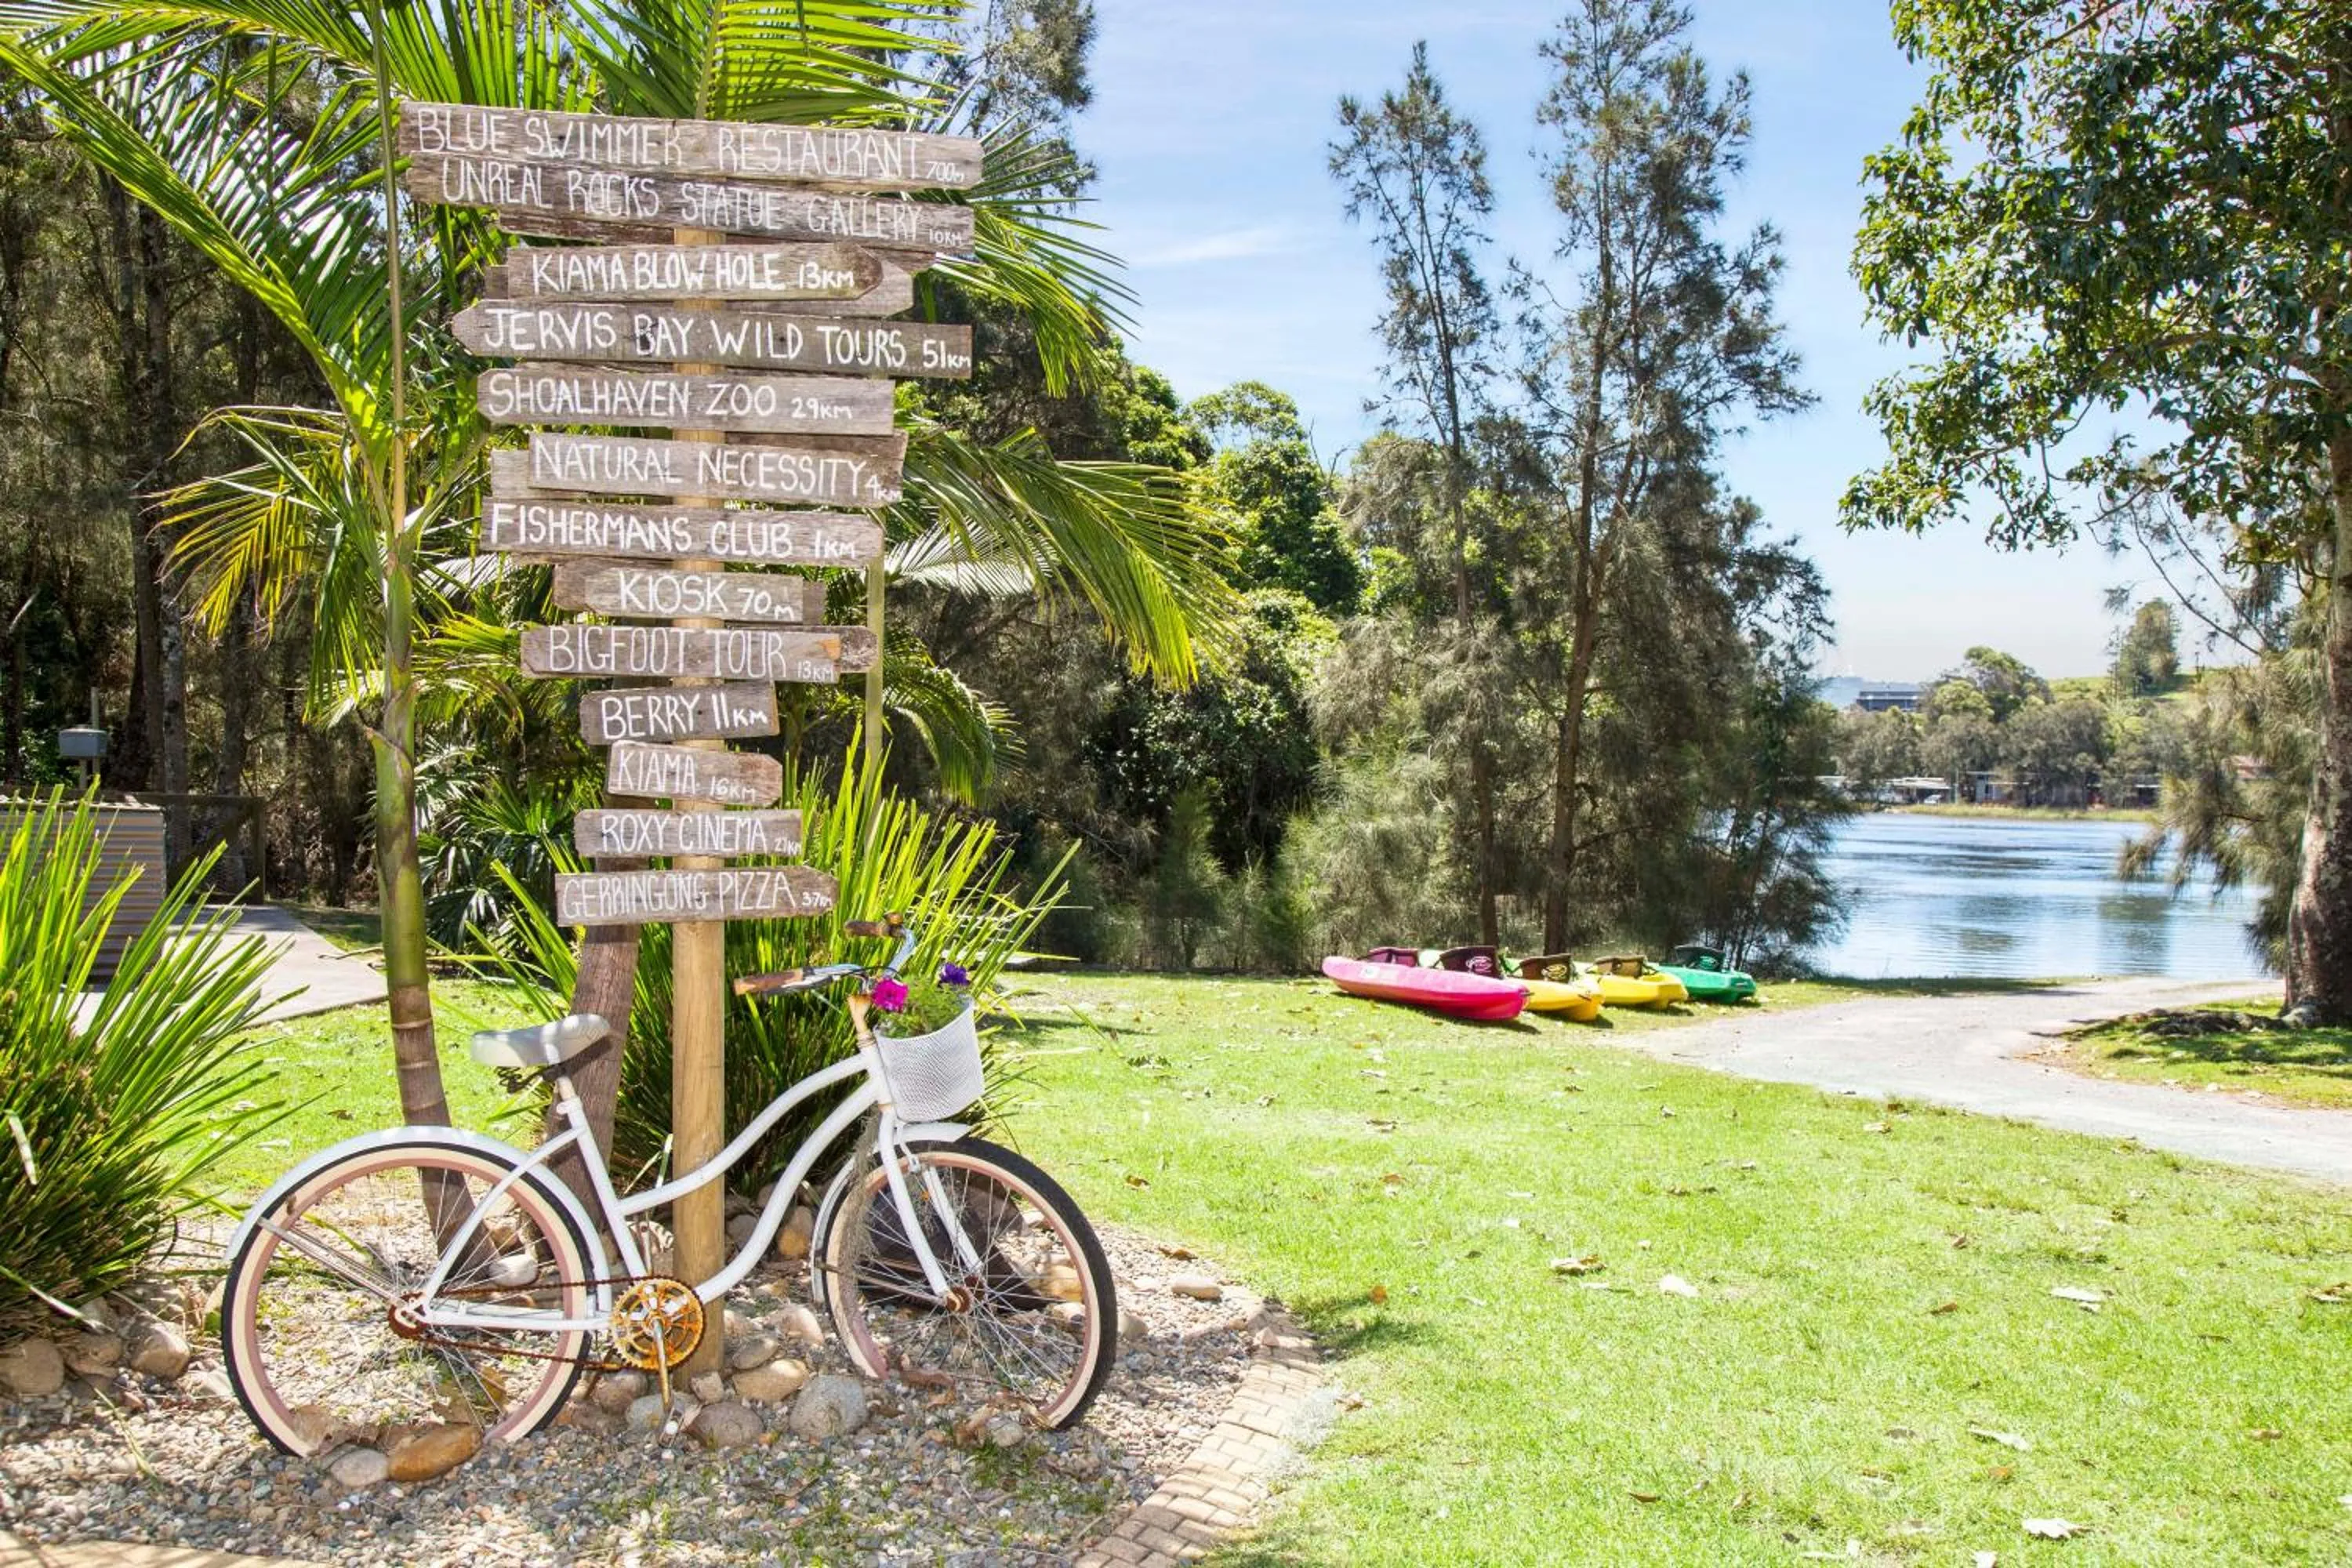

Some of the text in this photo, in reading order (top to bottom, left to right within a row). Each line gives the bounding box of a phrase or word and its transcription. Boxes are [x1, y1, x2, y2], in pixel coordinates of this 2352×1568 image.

[418, 108, 509, 154] BLUE
[524, 117, 682, 165] SWIMMER
[718, 126, 925, 180] RESTAURANT
[443, 157, 553, 209] UNREAL
[568, 170, 659, 218] ROCKS
[681, 181, 782, 230] STATUE
[808, 197, 923, 241] GALLERY
[532, 252, 628, 294] KIAMA
[633, 252, 706, 290] BLOW
[716, 252, 785, 291] HOLE
[484, 308, 617, 351] JERVIS
[633, 314, 695, 355] BAY
[710, 319, 804, 359] WILD
[816, 325, 907, 368] TOURS
[487, 372, 690, 417] SHOALHAVEN
[706, 383, 777, 417] ZOO
[535, 438, 684, 483] NATURAL
[697, 447, 866, 497] NECESSITY
[491, 503, 692, 553] FISHERMANS
[710, 521, 793, 558] CLUB
[619, 569, 729, 614] KIOSK
[550, 626, 696, 675] BIGFOOT
[706, 629, 786, 678] TOUR
[601, 693, 701, 740] BERRY
[618, 749, 696, 795] KIAMA
[601, 813, 674, 855] ROXY
[678, 814, 768, 855] CINEMA
[561, 871, 710, 919] GERRINGONG
[718, 870, 797, 913] PIZZA
